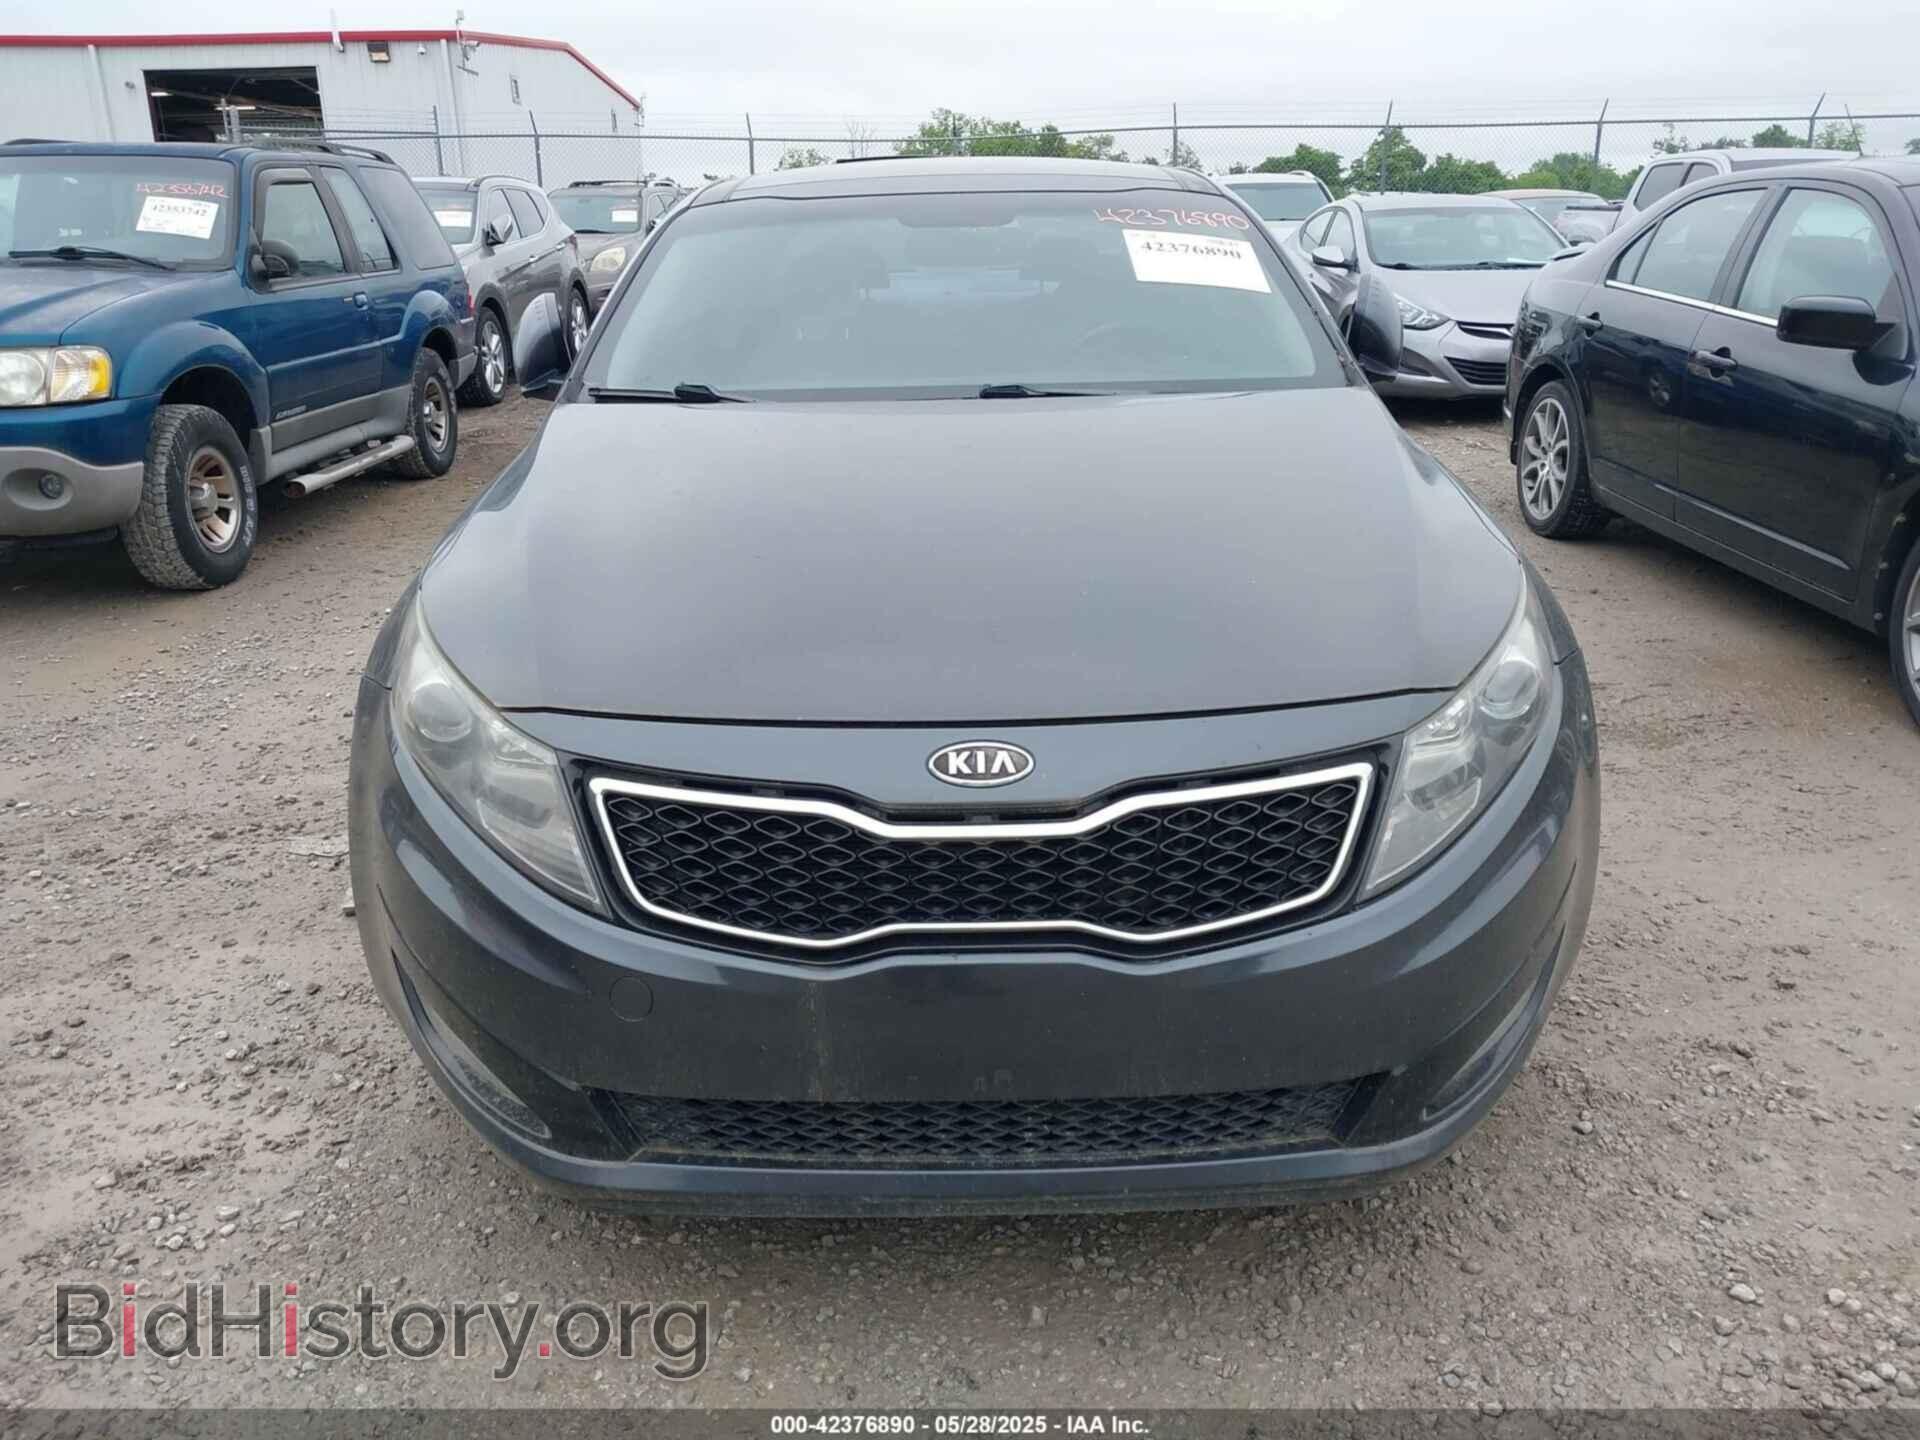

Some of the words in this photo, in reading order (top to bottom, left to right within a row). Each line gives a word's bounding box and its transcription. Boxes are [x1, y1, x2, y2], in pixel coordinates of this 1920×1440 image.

[1092, 208, 1250, 230] 42376890
[1140, 241, 1242, 259] 42376890
[947, 750, 1017, 774] KIA
